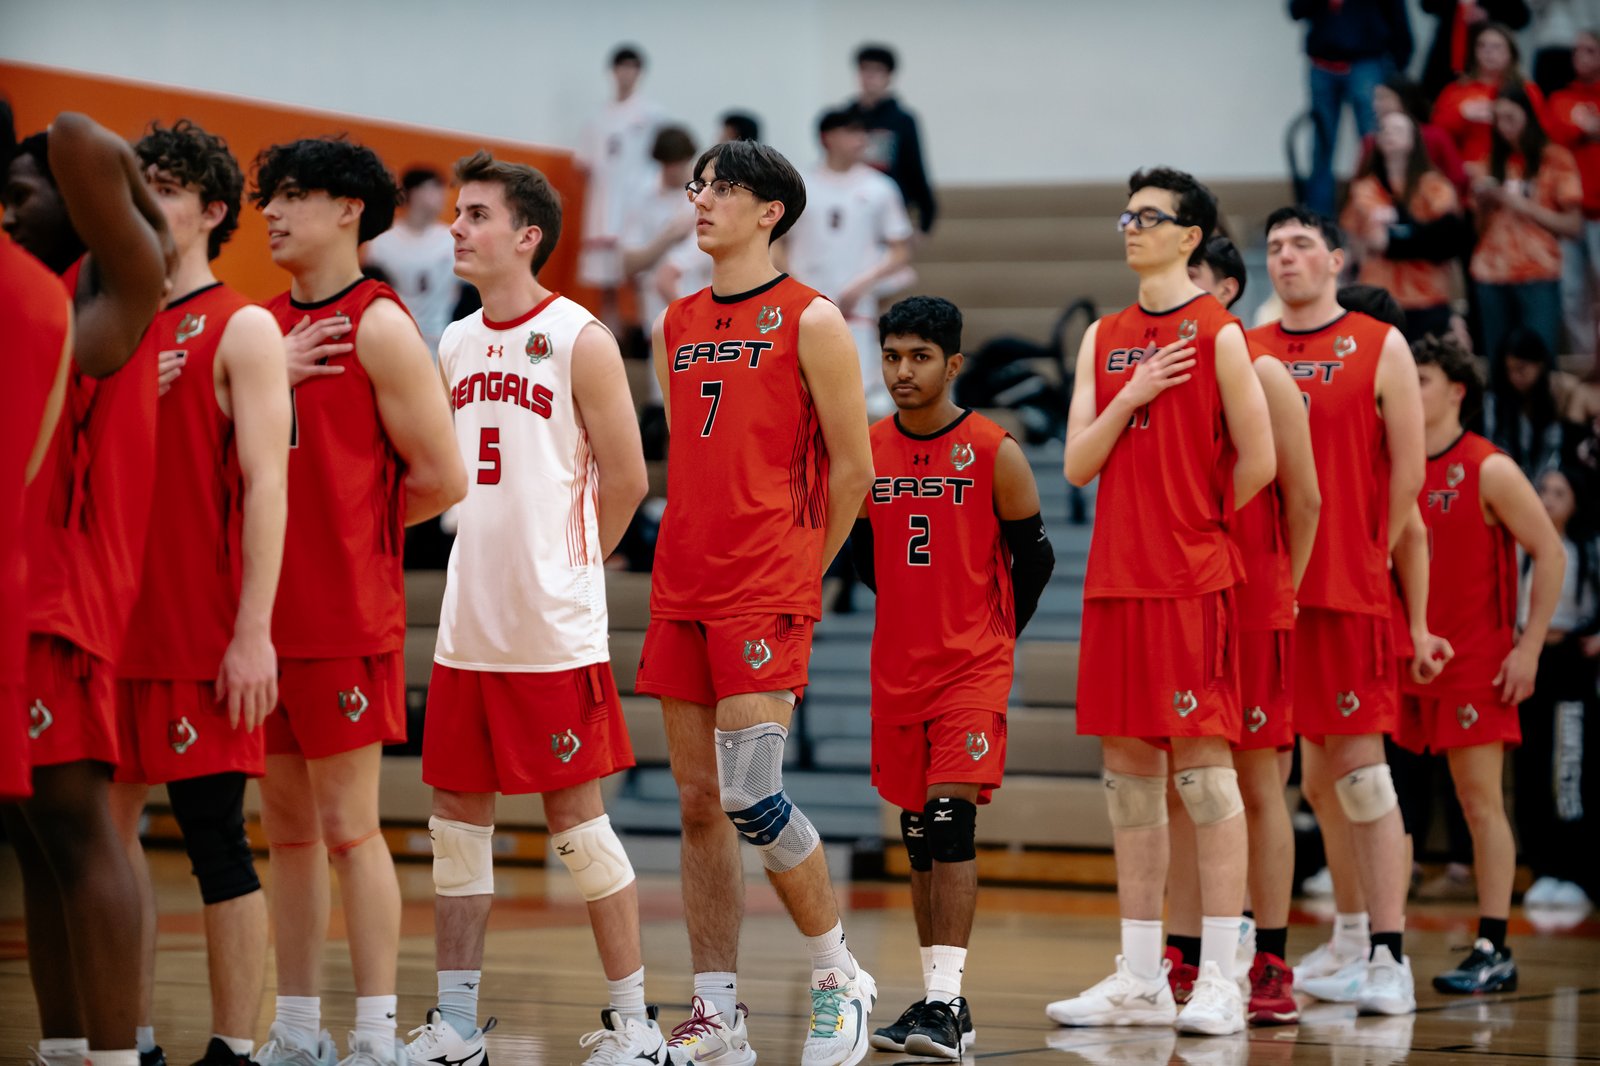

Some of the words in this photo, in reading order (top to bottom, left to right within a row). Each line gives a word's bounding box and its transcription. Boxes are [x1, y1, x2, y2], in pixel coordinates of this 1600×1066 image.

[673, 340, 773, 372] EAST
[1106, 347, 1163, 373] EA
[1284, 361, 1344, 384] ST
[700, 380, 722, 437] 7
[477, 427, 501, 485] 5
[872, 476, 974, 505] EAST
[907, 514, 930, 566] 2
